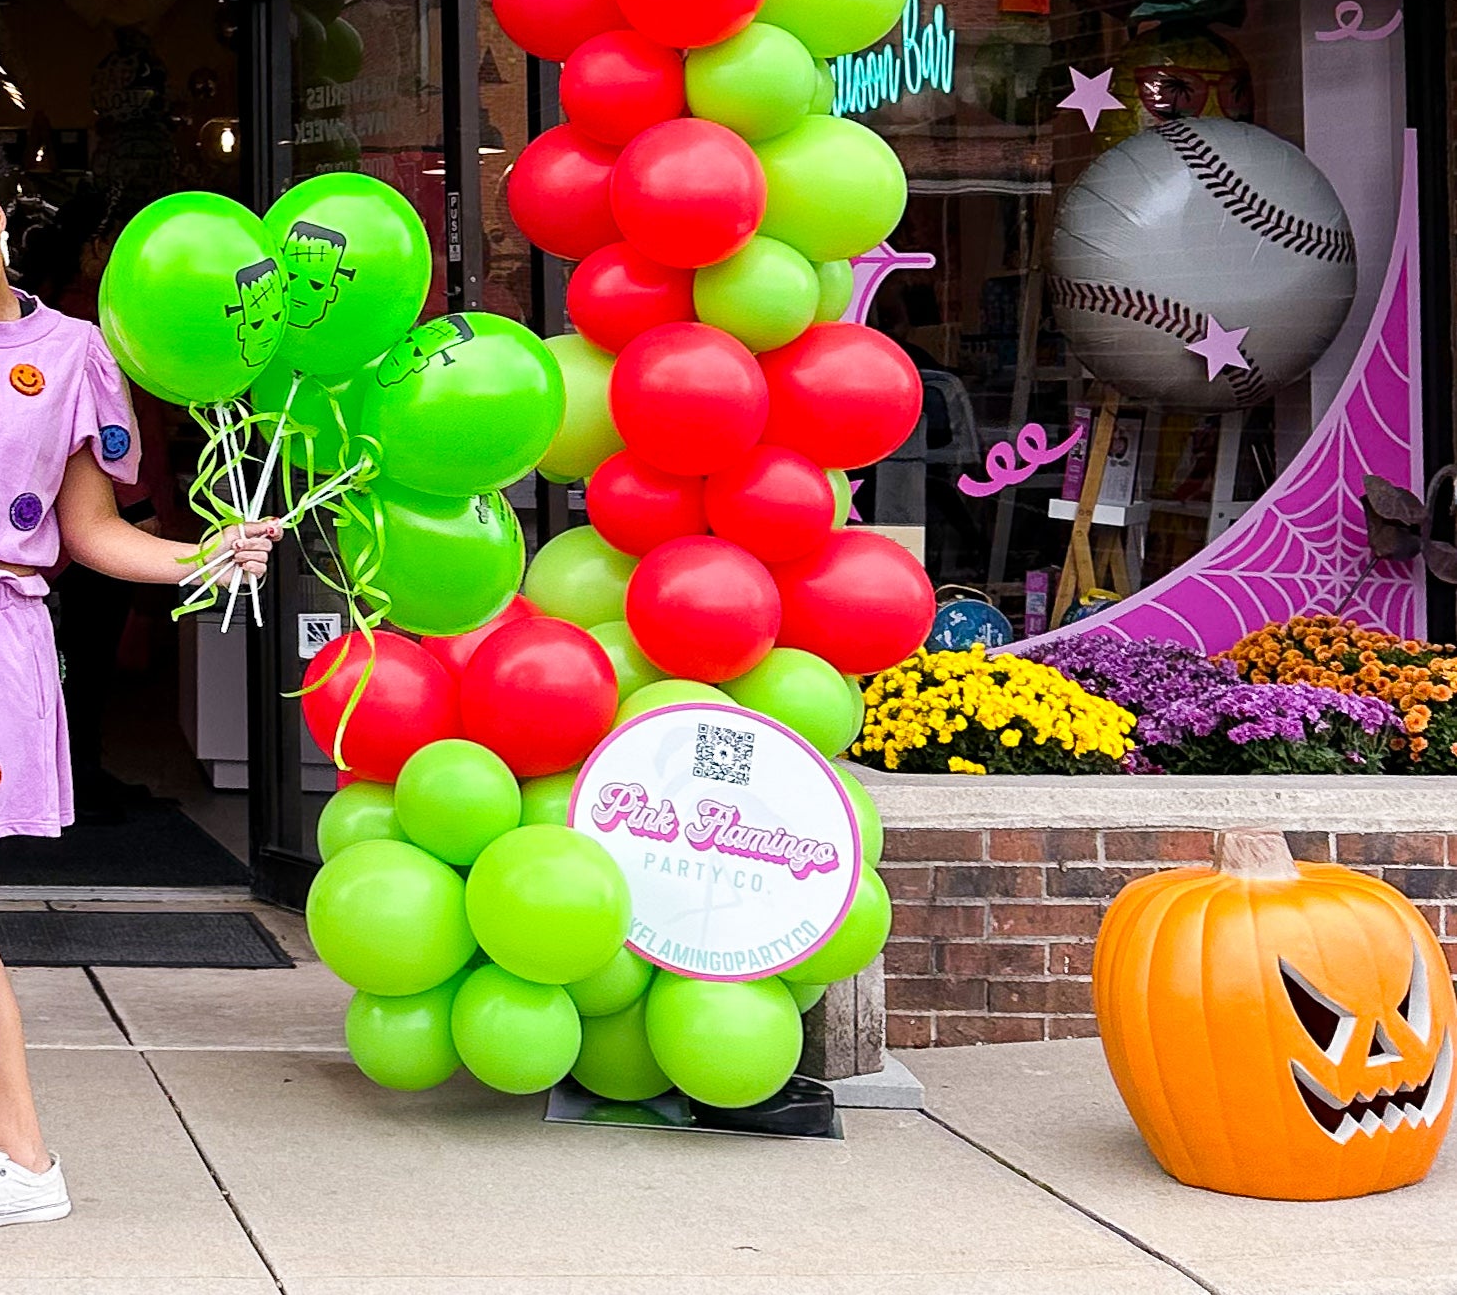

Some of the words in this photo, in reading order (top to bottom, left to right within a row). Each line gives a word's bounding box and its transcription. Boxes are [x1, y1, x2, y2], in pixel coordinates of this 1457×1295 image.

[831, 44, 900, 118] lloon
[450, 196, 458, 243] PUSH
[591, 782, 679, 843] Pink
[685, 799, 839, 880] Flamingo
[643, 852, 724, 884] PARTY
[733, 870, 772, 896] CO.
[628, 917, 820, 972] KFLAMINGOPARTY.CO
